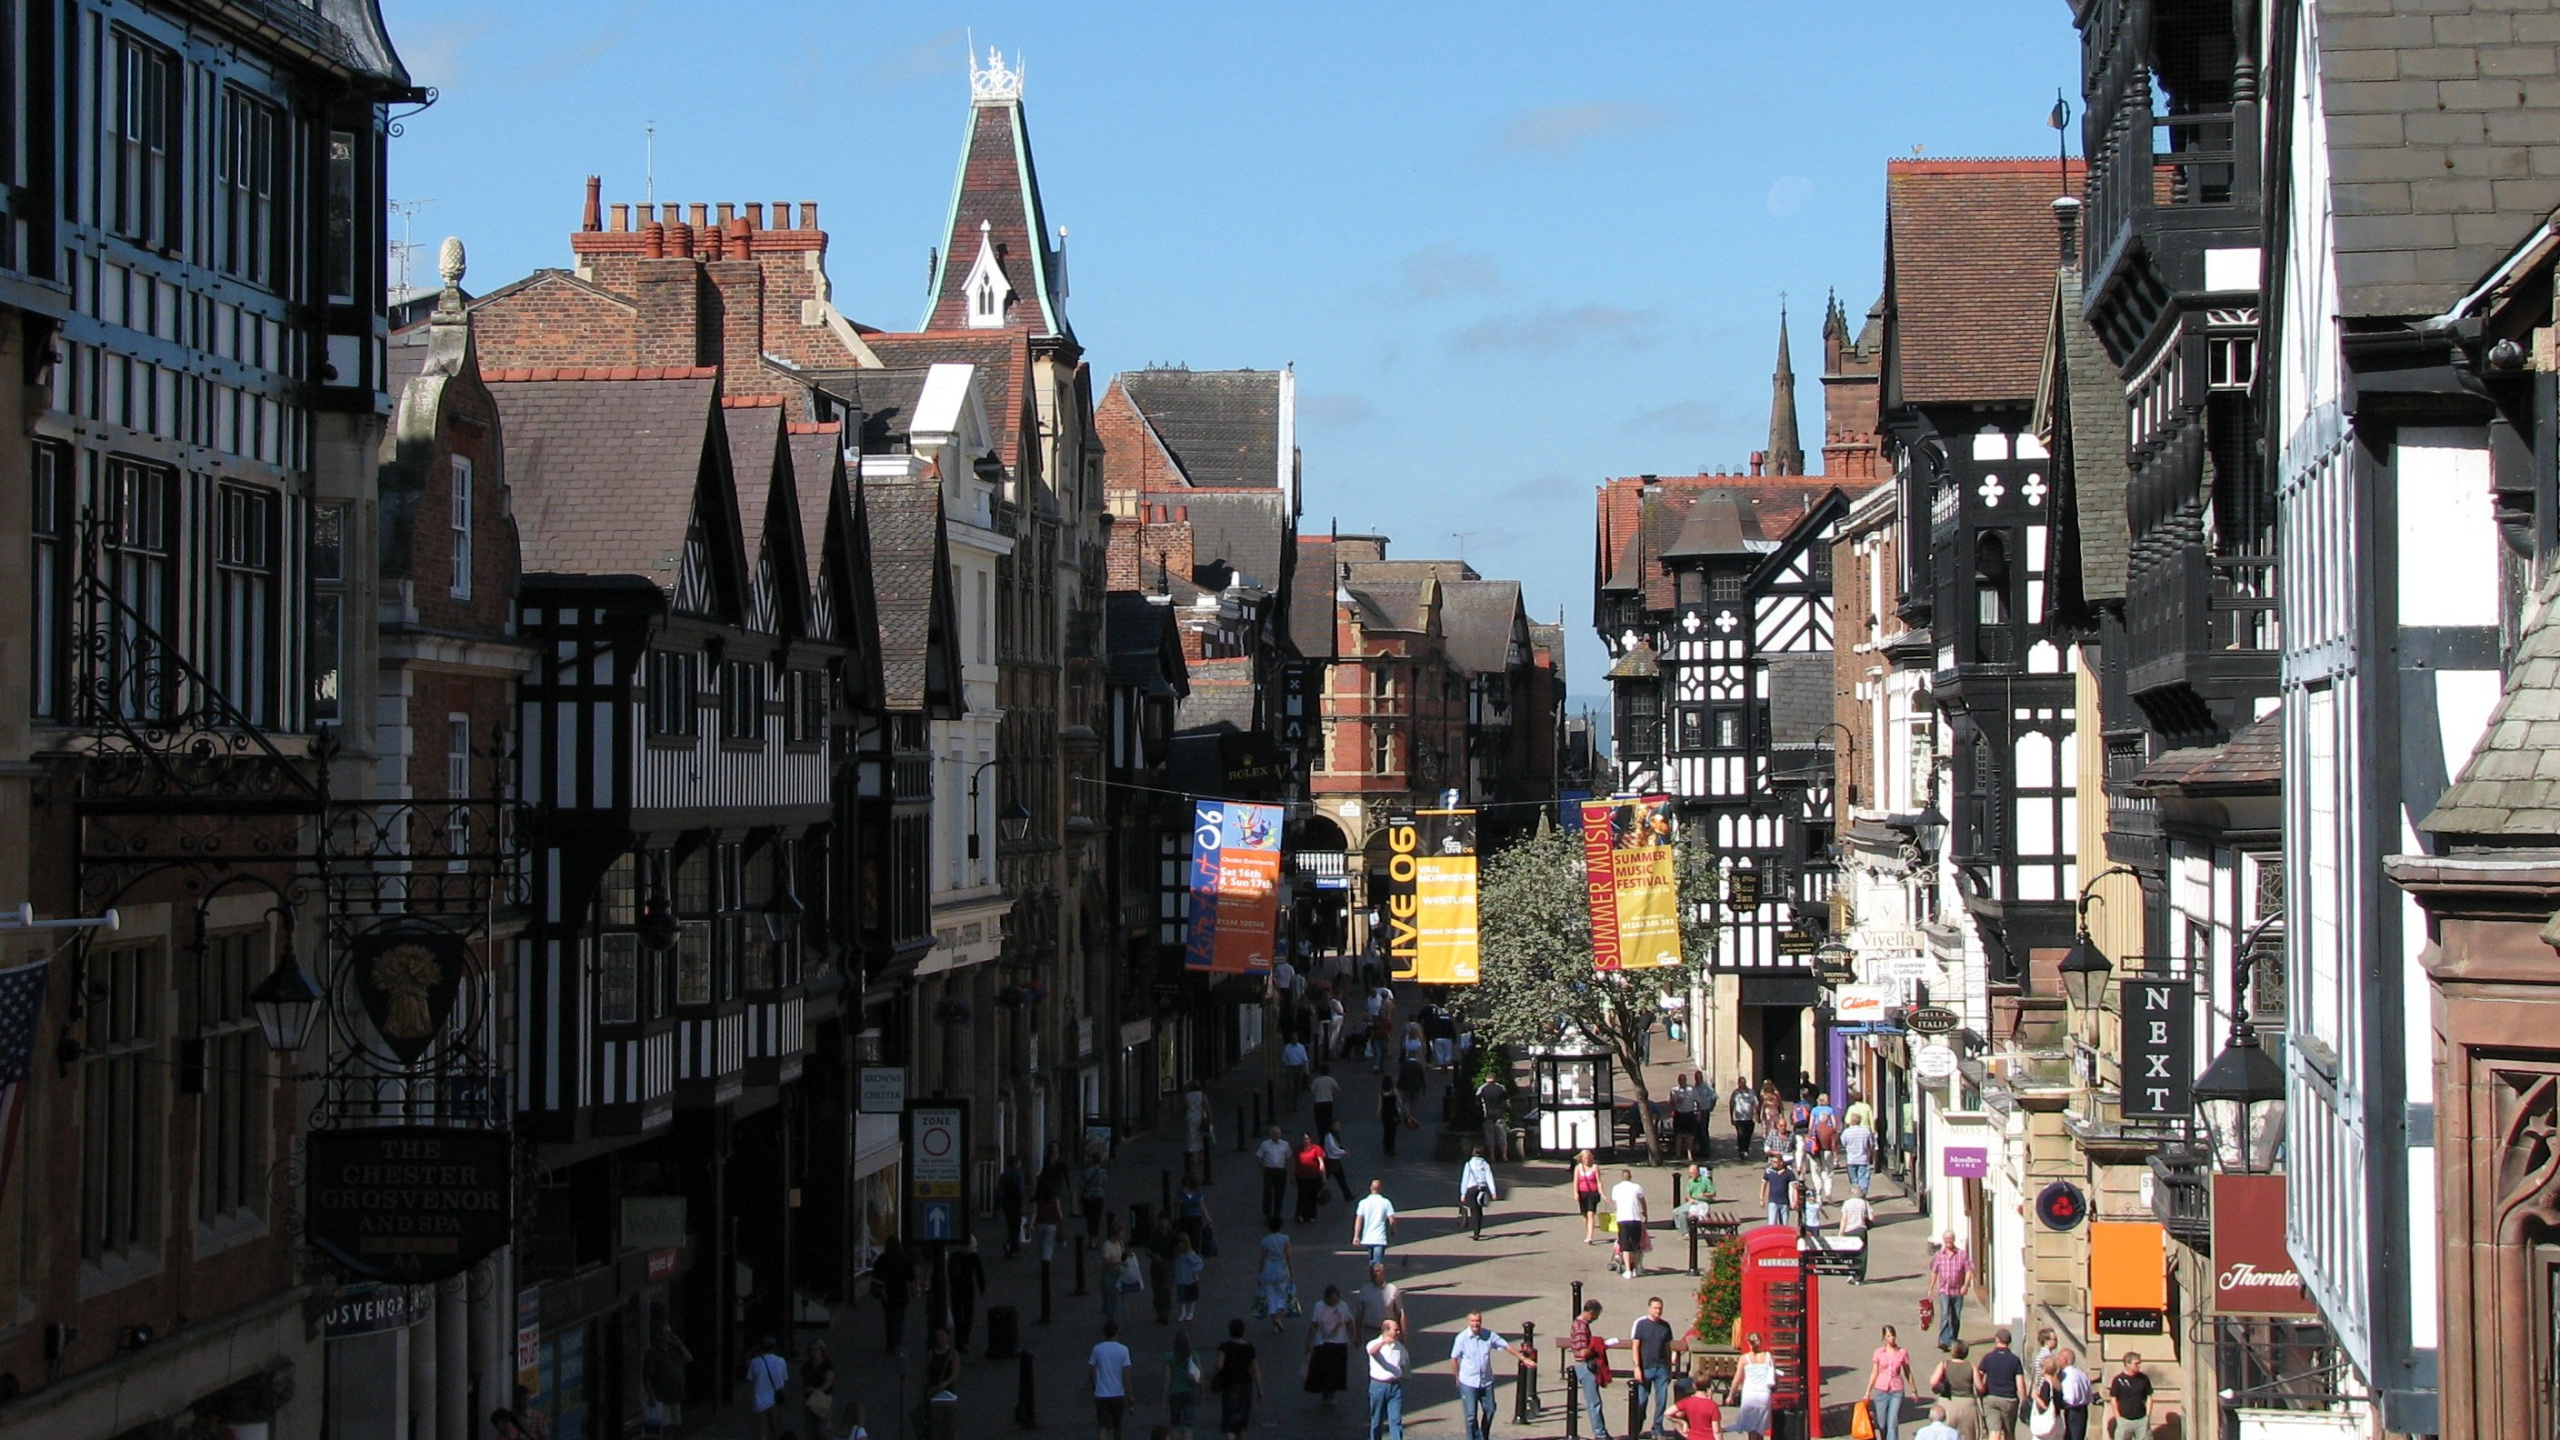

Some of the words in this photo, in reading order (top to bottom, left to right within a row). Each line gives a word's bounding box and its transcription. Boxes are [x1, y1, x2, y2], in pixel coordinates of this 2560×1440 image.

[1228, 766, 1268, 780] ROLEX
[1583, 811, 1612, 874] MUSIC
[1389, 825, 1417, 882] 06
[1615, 851, 1666, 864] SUMMER
[1220, 866, 1236, 877] Sat
[1238, 868, 1262, 879] 16th
[1418, 865, 1440, 874] VAN
[1616, 864, 1654, 877] MUSIC
[1219, 876, 1228, 886] &
[1230, 878, 1249, 887] Sun
[1250, 879, 1274, 890] 17th
[1417, 873, 1476, 882] MORRISON
[1617, 875, 1669, 890] FESTIVAL
[1217, 886, 1262, 896] September
[1421, 895, 1475, 905] WESTLIFE
[1589, 881, 1619, 969] SUMMER
[1390, 894, 1417, 979] LIVE
[1893, 968, 1924, 976] culture
[1917, 1020, 1949, 1029] ITALIA
[2144, 987, 2172, 1111] NEXT
[864, 1073, 902, 1083] BROWNS
[864, 1090, 901, 1100] CHESTER
[922, 1117, 951, 1126] ZONE
[1950, 1126, 1982, 1135] MOSS
[381, 1139, 441, 1160] THE
[341, 1165, 482, 1186] CHESTER
[320, 1190, 502, 1211] GROSVENOR
[359, 1215, 414, 1234] AND
[418, 1215, 463, 1234] SPA
[392, 1253, 422, 1270] AA
[2219, 1262, 2299, 1291] Thornto
